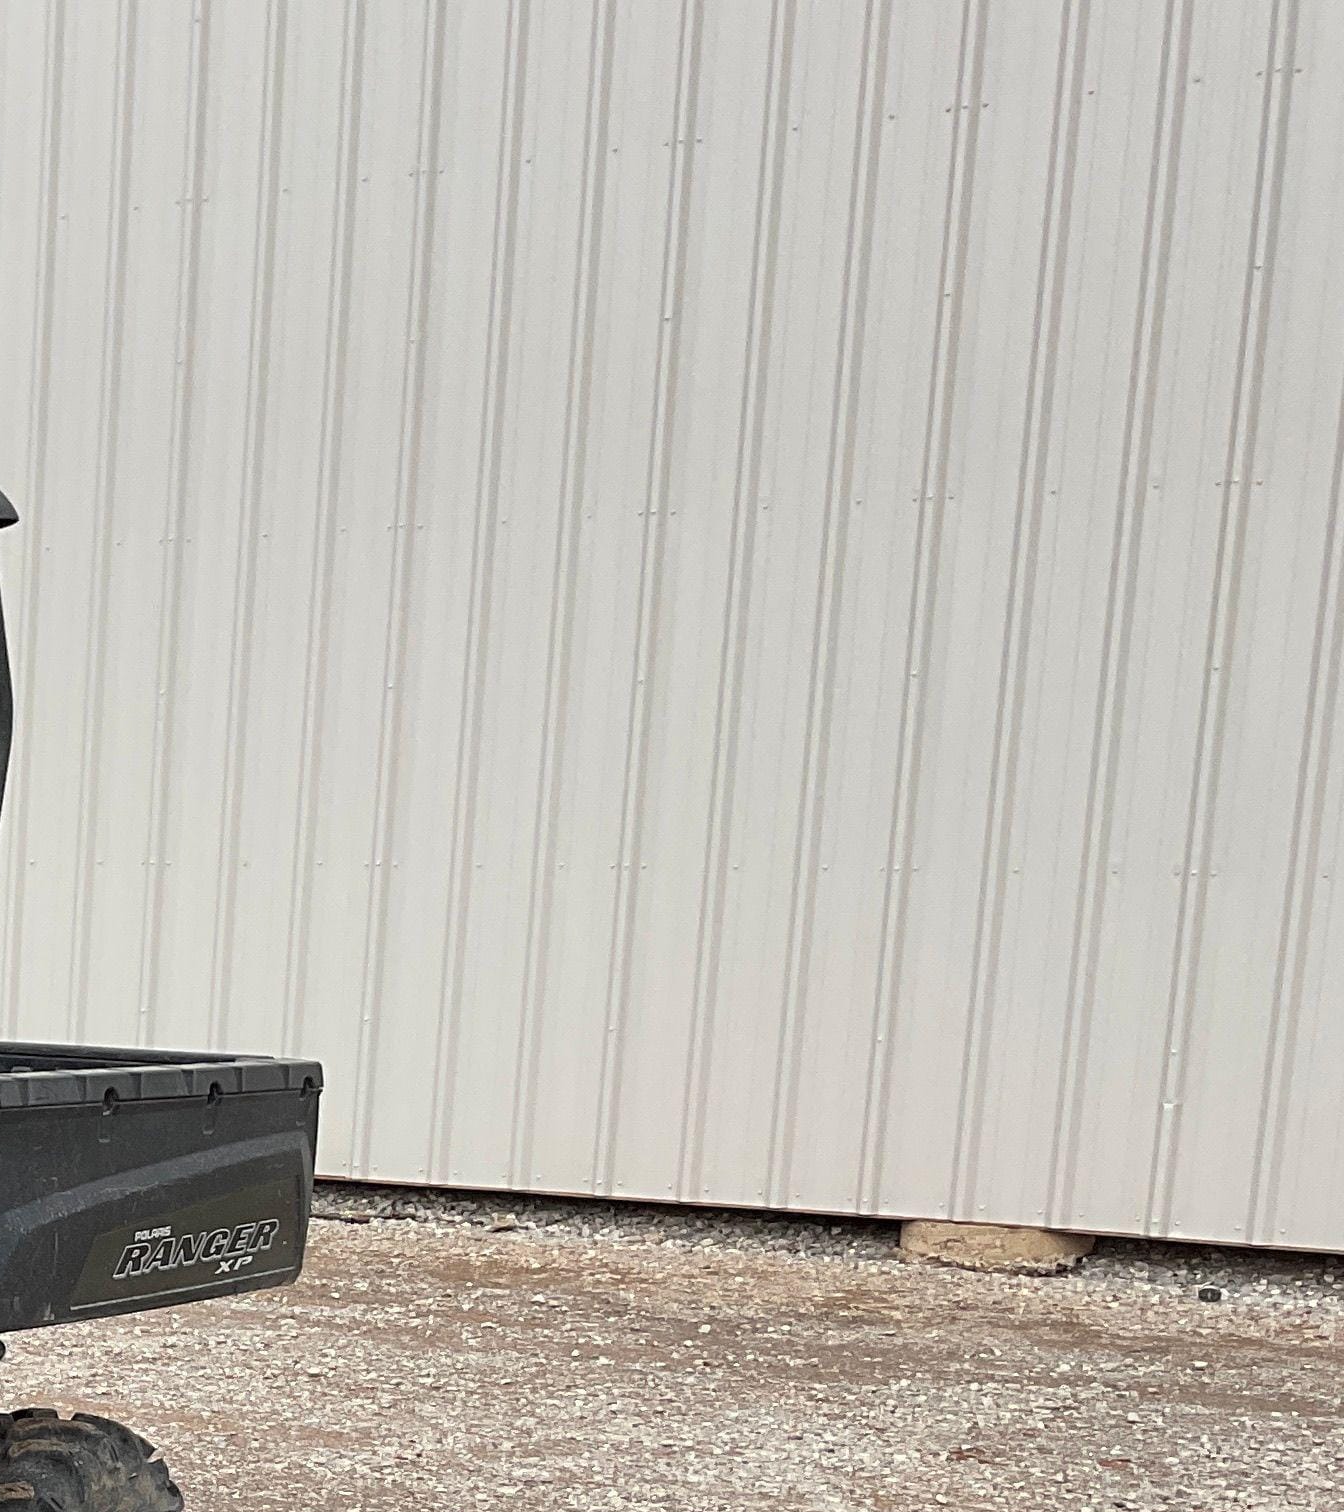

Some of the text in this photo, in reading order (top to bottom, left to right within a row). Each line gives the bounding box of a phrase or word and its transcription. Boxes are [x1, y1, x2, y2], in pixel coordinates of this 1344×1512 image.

[134, 1225, 172, 1242] POLARIS
[112, 1218, 280, 1280] RANGER
[214, 1255, 254, 1275] XP
